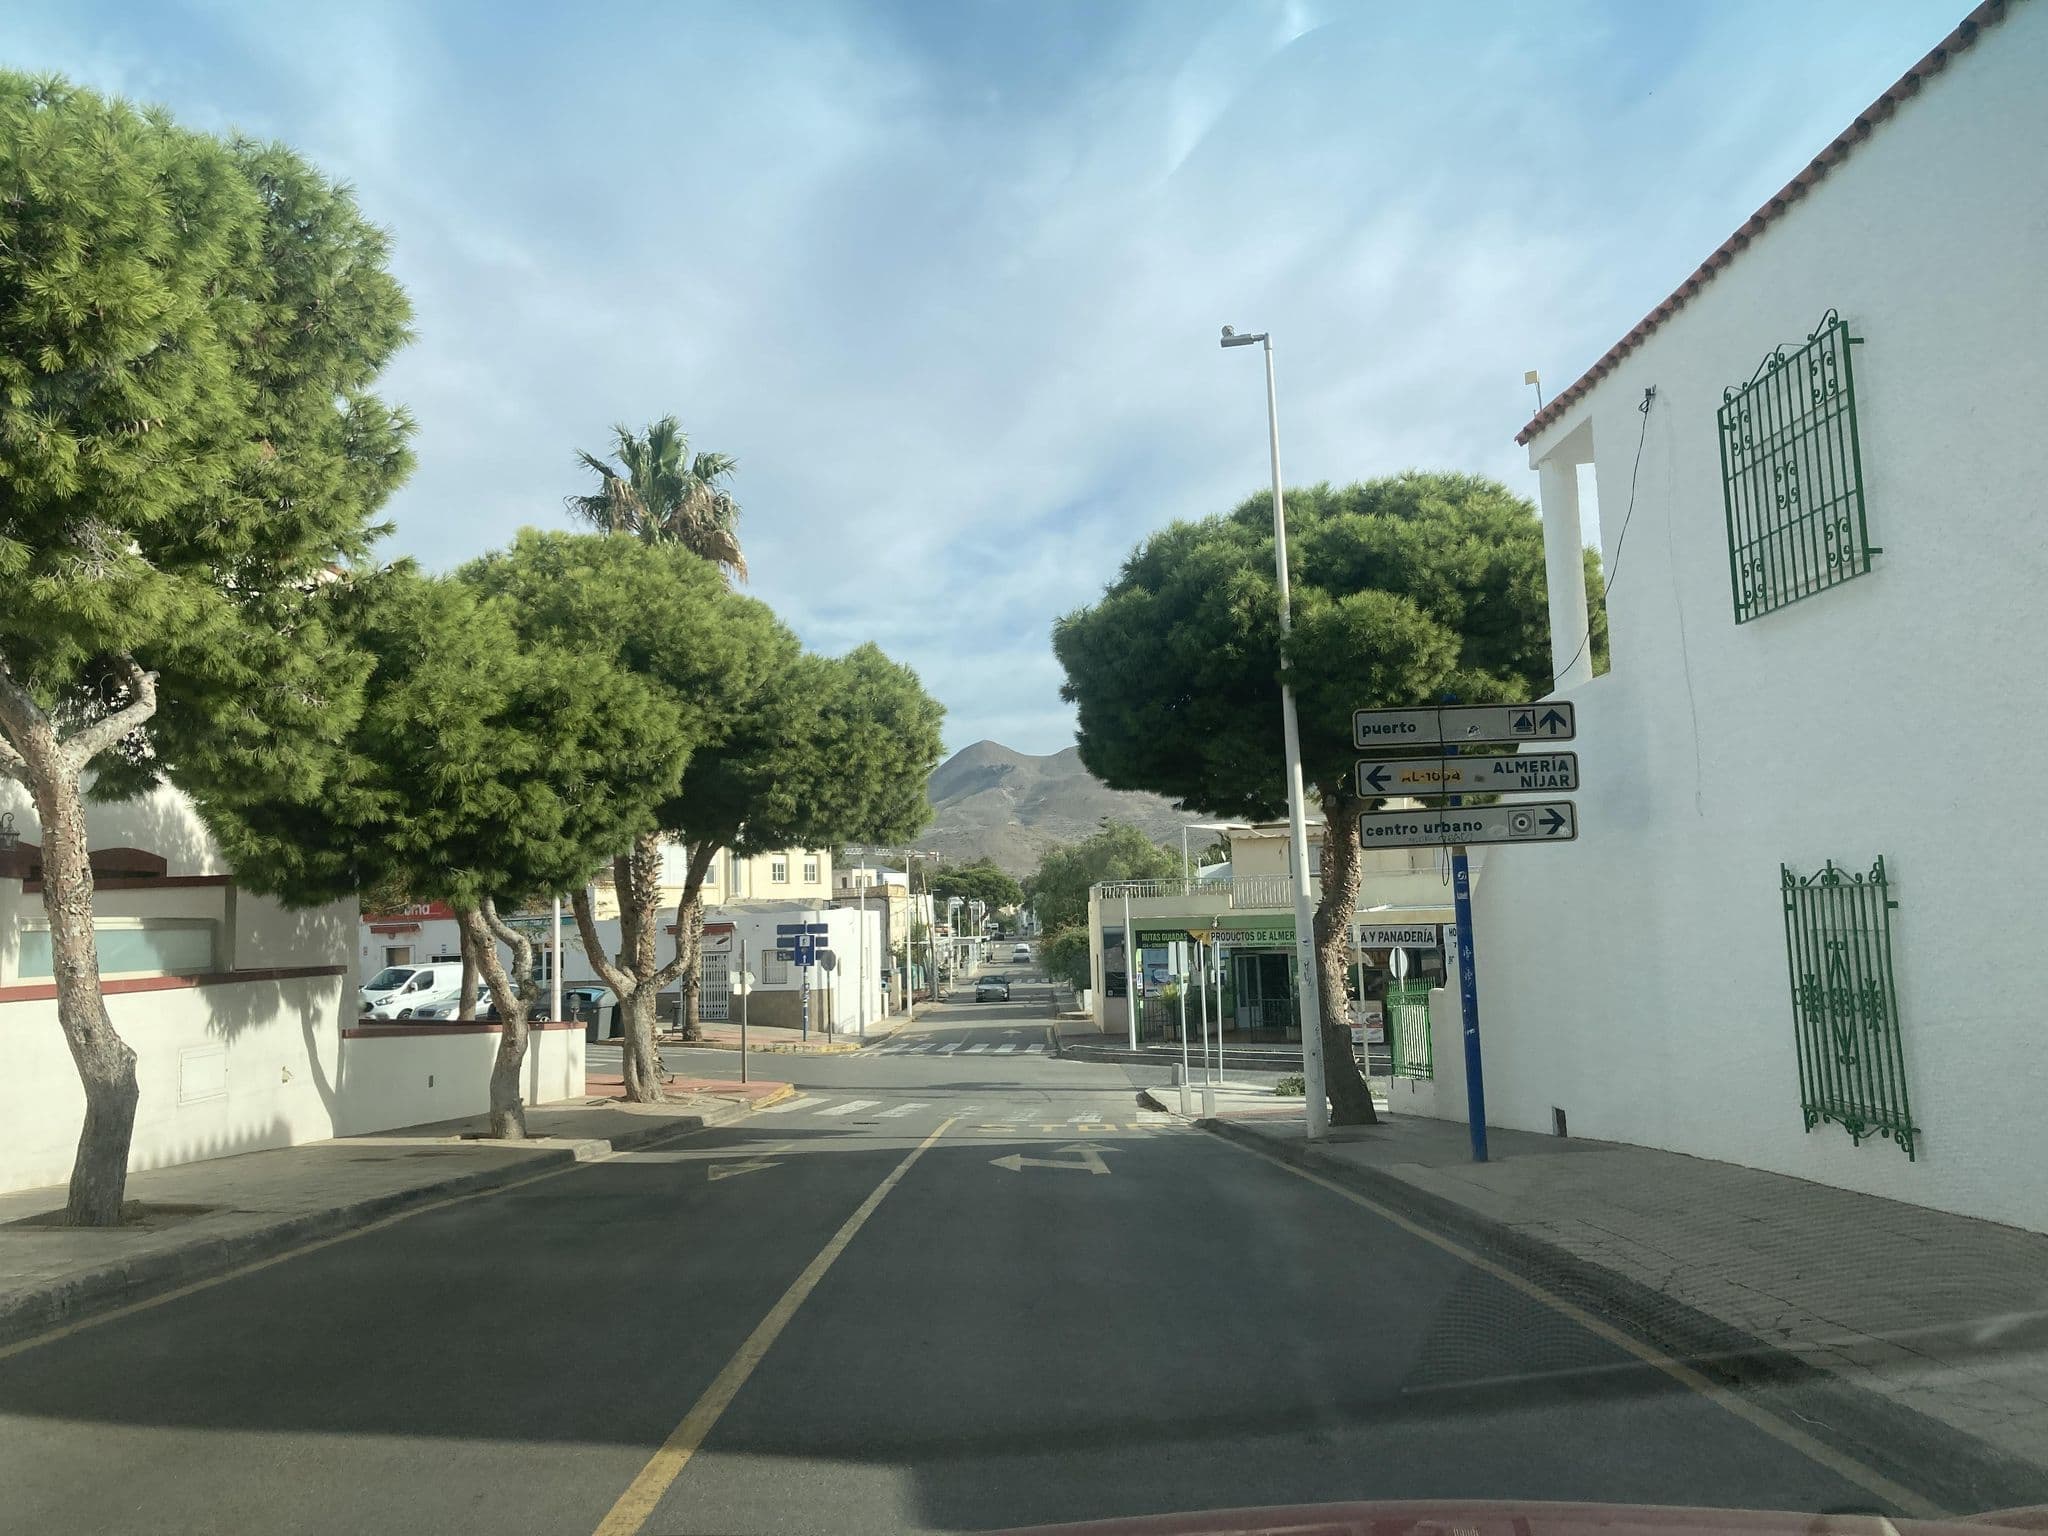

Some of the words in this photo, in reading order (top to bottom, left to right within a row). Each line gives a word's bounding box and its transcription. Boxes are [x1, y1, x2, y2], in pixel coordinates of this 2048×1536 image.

[1362, 723, 1417, 738] puerto
[1493, 756, 1569, 774] ALMERÍA
[1520, 773, 1570, 788] NÍJAR
[1366, 823, 1418, 837] centro
[1424, 820, 1483, 834] urbano
[1211, 931, 1255, 942] PRODUCTOS
[1257, 931, 1267, 942] DE
[1268, 930, 1295, 942] ALMER
[1369, 932, 1377, 943] Y
[1378, 928, 1434, 943] PANADERÍA
